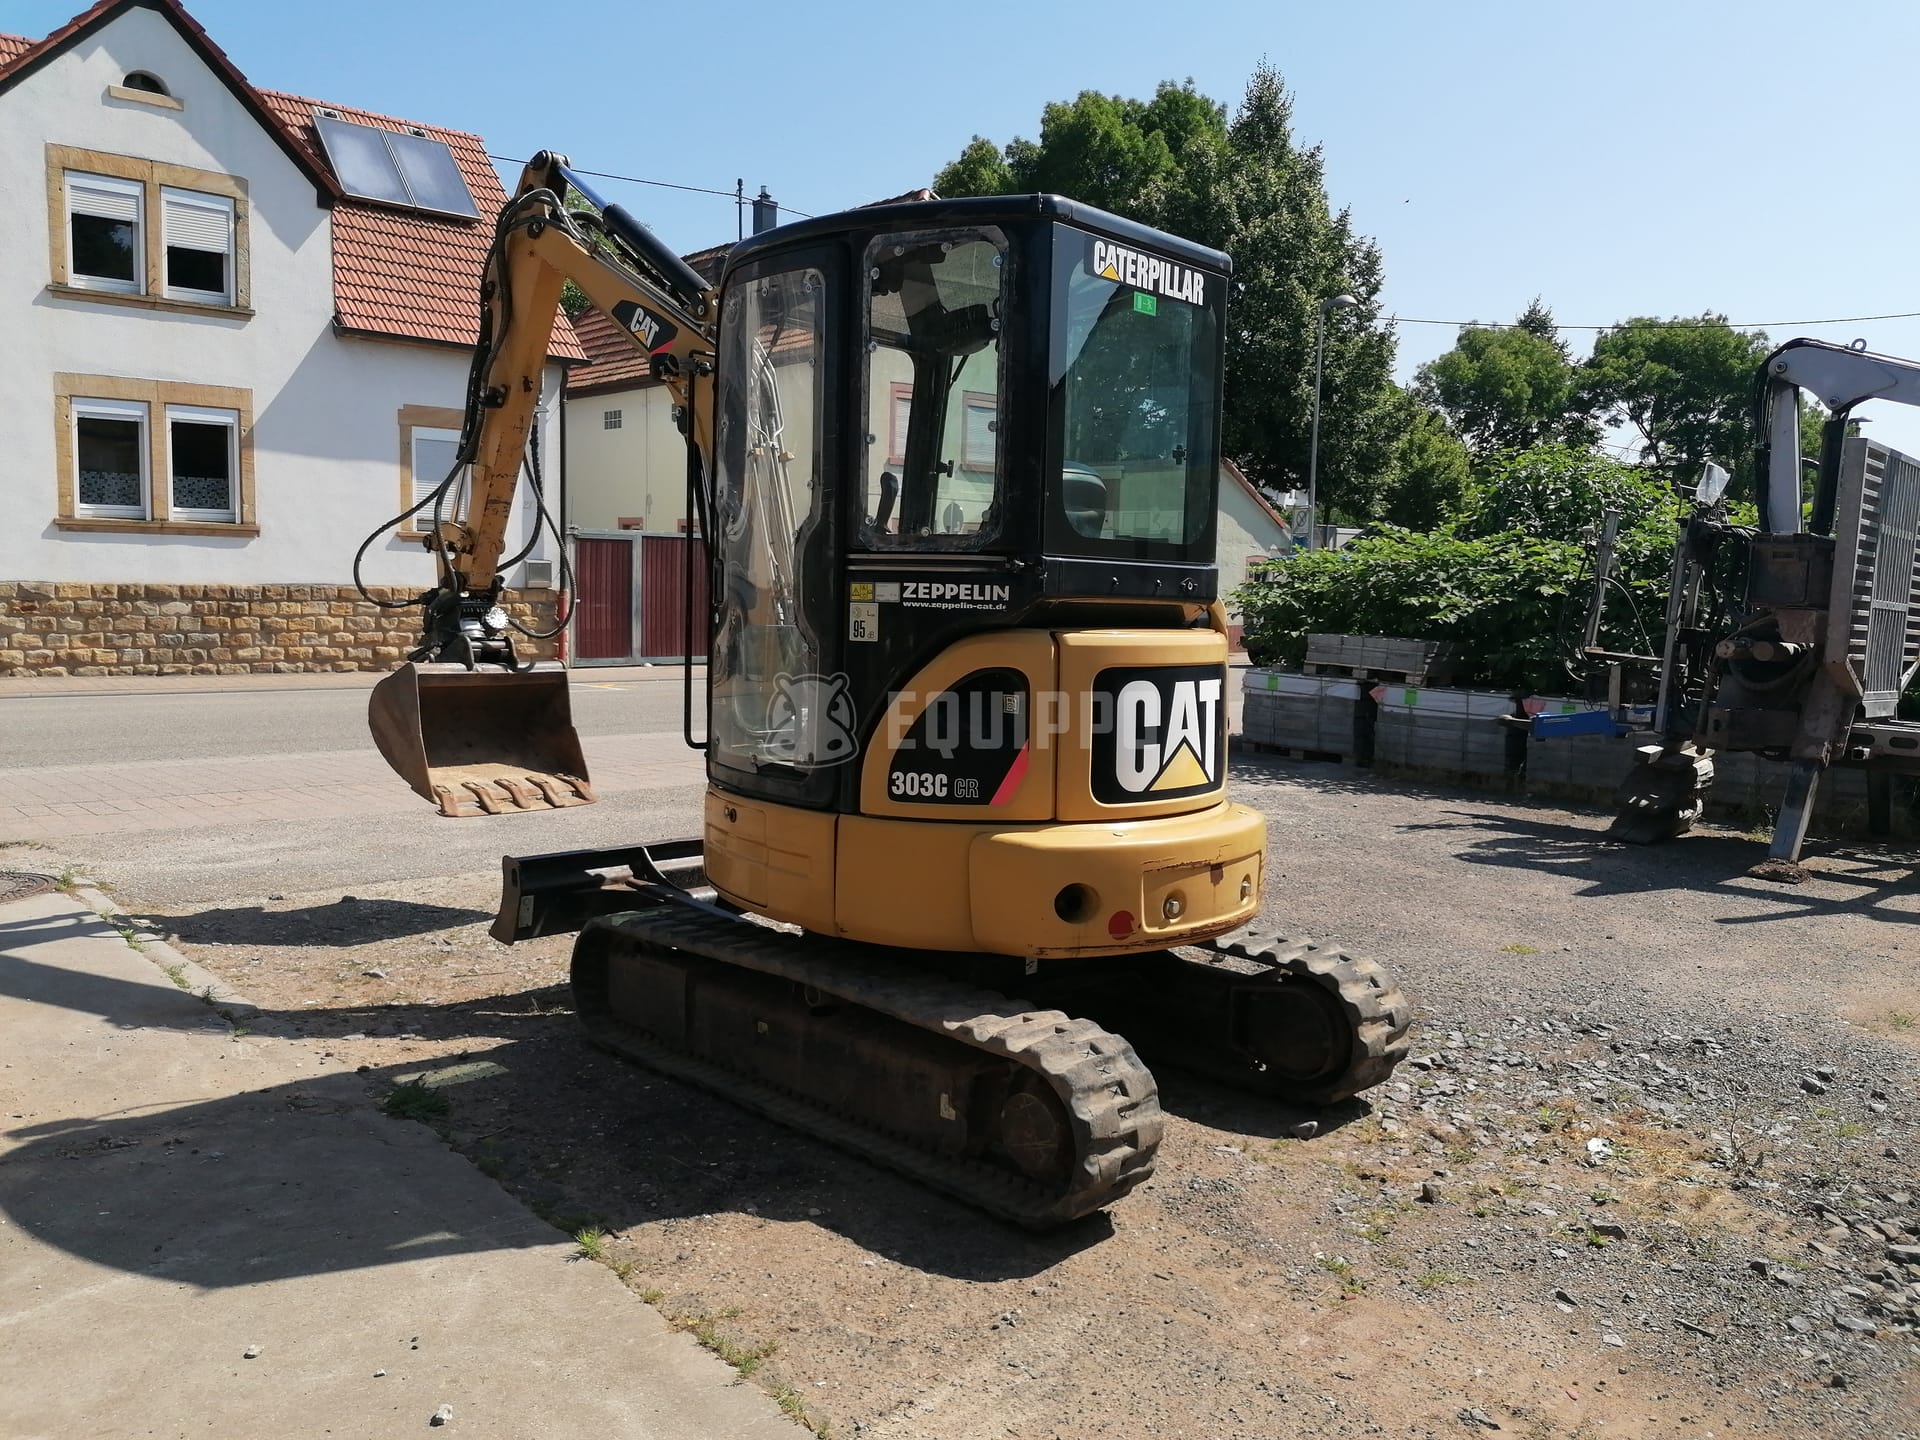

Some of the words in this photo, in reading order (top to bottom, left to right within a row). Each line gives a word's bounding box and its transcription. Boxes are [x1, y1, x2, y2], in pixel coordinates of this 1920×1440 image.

[1094, 241, 1204, 305] CATERPILLAR
[630, 307, 660, 348] CAT
[903, 582, 1009, 601] ZEPPELIN
[853, 620, 866, 638] 95
[1116, 679, 1222, 792] CAT
[891, 771, 948, 797] 303C
[954, 778, 979, 798] CR
